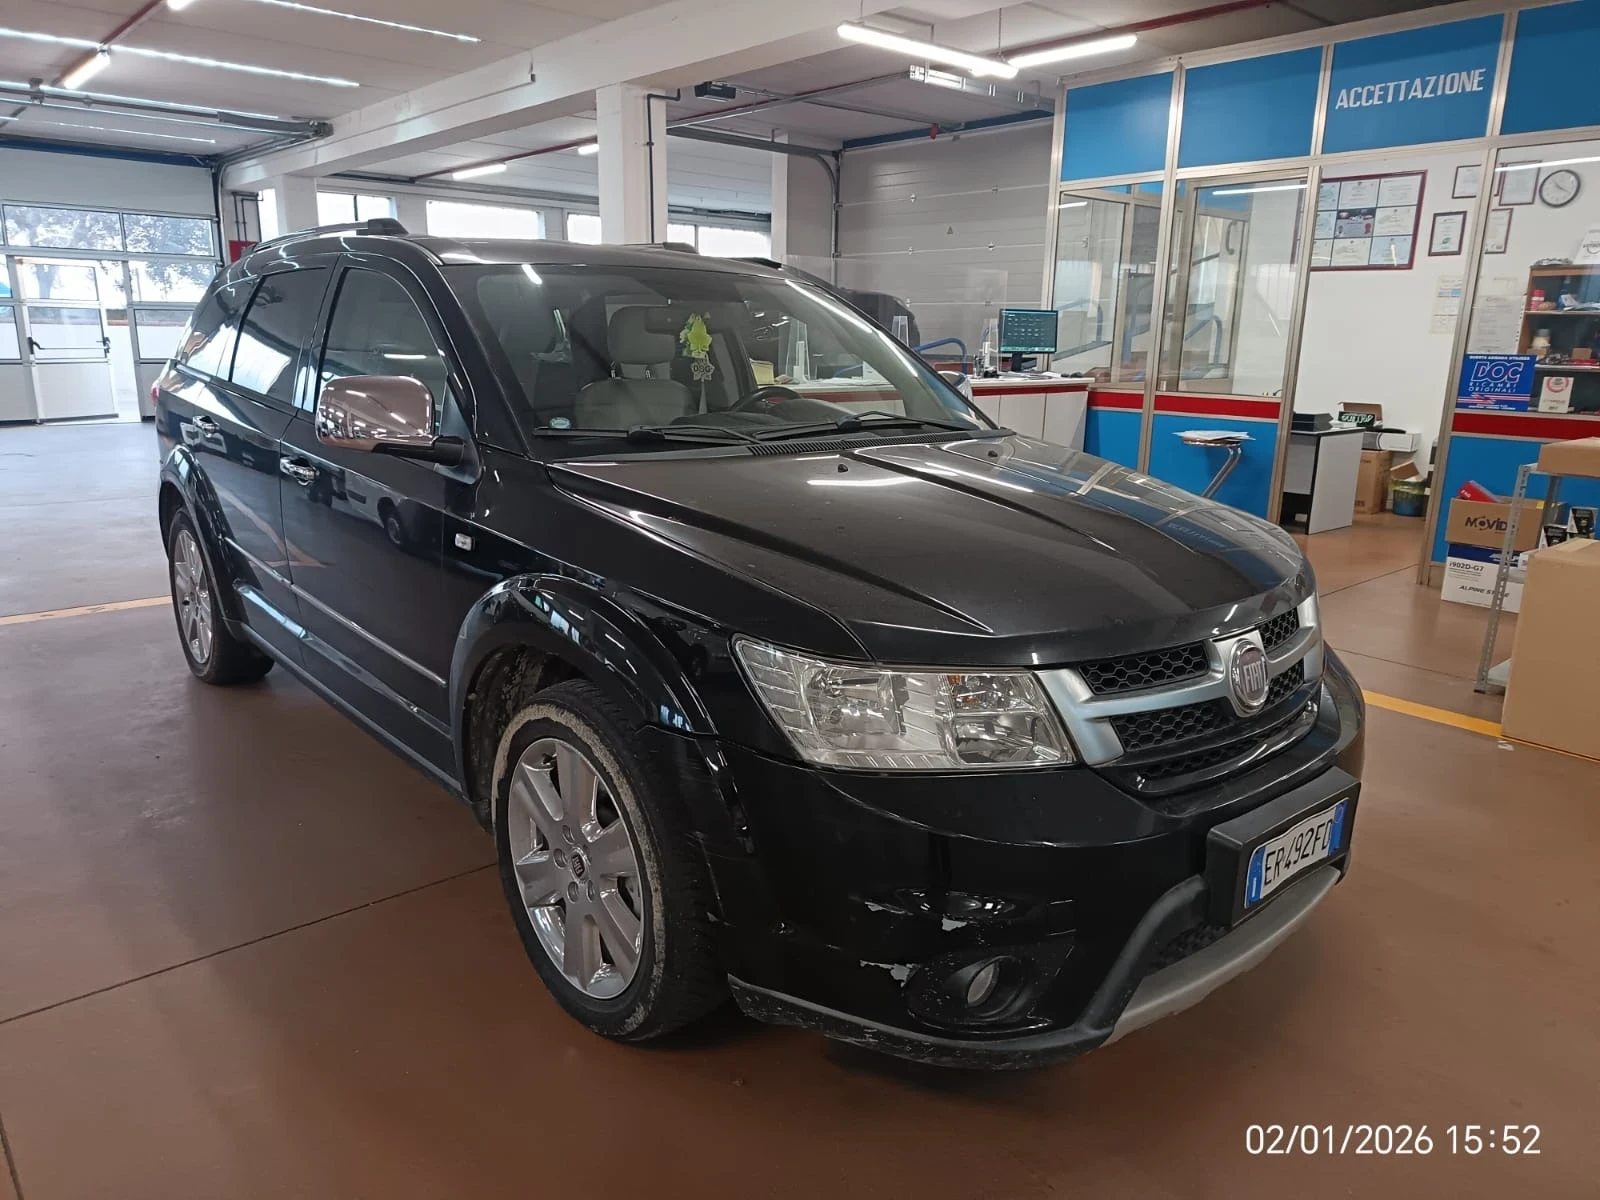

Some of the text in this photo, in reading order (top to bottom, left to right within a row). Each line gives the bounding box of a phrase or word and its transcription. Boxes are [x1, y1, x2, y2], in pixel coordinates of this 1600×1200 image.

[1335, 68, 1486, 110] ACCETTAZIONE
[1471, 361, 1524, 383] DOC
[1459, 585, 1485, 594] ALPINE
[1242, 660, 1265, 693] FIAT
[1264, 818, 1333, 886] ER492FD
